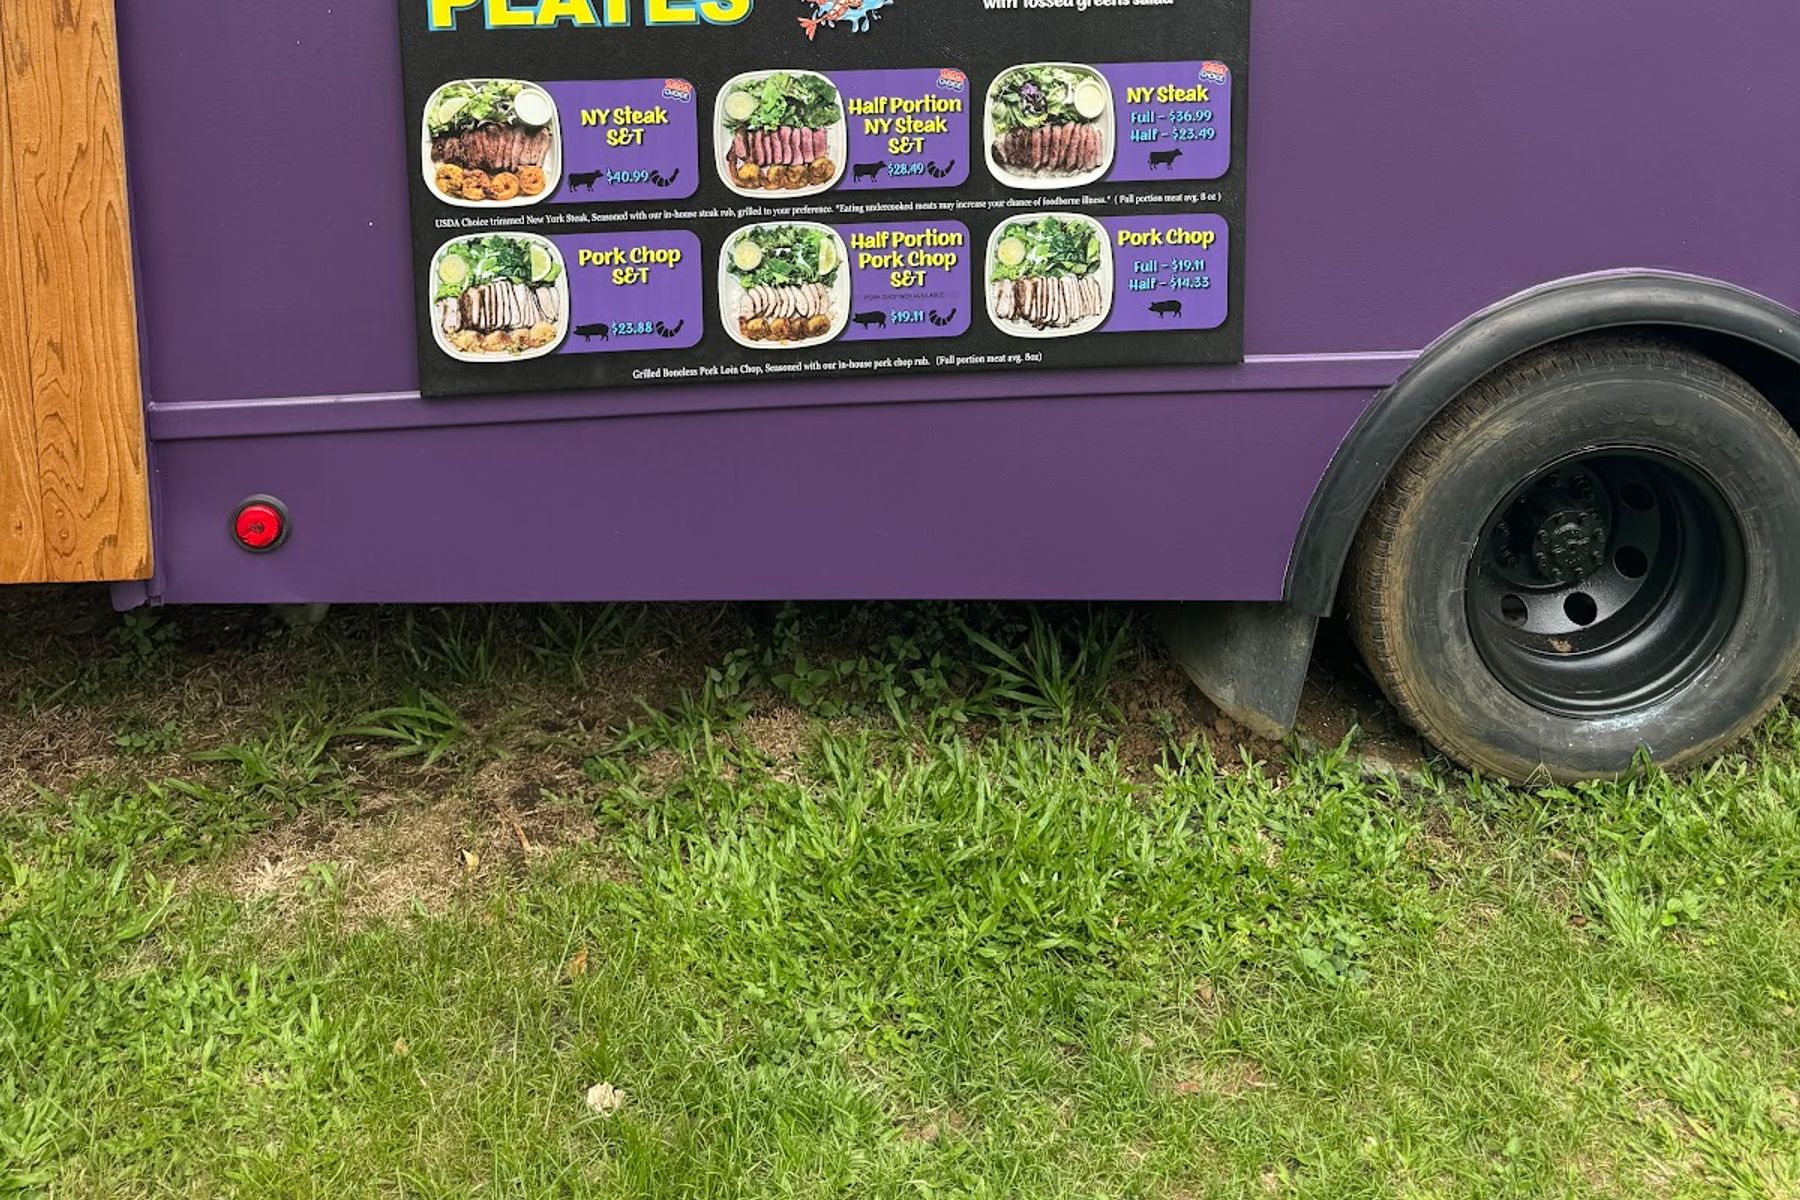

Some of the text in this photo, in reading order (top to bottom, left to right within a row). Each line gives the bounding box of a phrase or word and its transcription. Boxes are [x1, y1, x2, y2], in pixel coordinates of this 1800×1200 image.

[1126, 84, 1209, 104] NY Steak
[848, 94, 962, 115] Half Portion
[581, 105, 669, 126] NY Steak
[1130, 110, 1155, 124] Full
[1169, 109, 1212, 124] $36.99
[864, 115, 948, 135] NY Steak
[1130, 128, 1158, 141] Half
[1172, 126, 1215, 141] $23.49
[606, 128, 645, 146] S&T
[888, 136, 925, 154] S&T
[606, 168, 649, 184] $40.99
[888, 162, 924, 177] $28.49
[435, 218, 460, 228] USDA
[461, 217, 489, 227] Choice
[490, 215, 525, 226] trimmed
[526, 216, 544, 225] New
[546, 214, 565, 224] York
[566, 212, 591, 224] Steak,
[591, 211, 628, 223] Seasoned
[629, 208, 647, 220] with
[648, 211, 662, 220] our
[663, 207, 697, 219] in-house
[699, 207, 719, 218] steak
[720, 207, 736, 219] rub,
[737, 206, 762, 218] grilled
[763, 207, 772, 216] to
[772, 207, 791, 218] your
[792, 205, 834, 217] preference.
[866, 201, 914, 212] undercooked
[915, 201, 938, 211] meats
[939, 202, 955, 212] may
[956, 199, 986, 210] increase
[987, 200, 1005, 211] your
[1006, 197, 1033, 207] chance
[1033, 197, 1042, 207] of
[1042, 195, 1080, 207] foodborne
[1119, 193, 1135, 204] Full
[1135, 193, 1163, 205] portion
[1164, 193, 1183, 203] meat
[1184, 194, 1199, 204] avg.
[1200, 192, 1206, 201] 8
[851, 228, 963, 249] Half Portion
[1117, 227, 1215, 250] Pork Chop
[578, 245, 681, 268] Pork Chop
[858, 249, 957, 272] Pork Chop
[1133, 260, 1158, 273] Full
[1171, 257, 1205, 273] $19.11
[611, 267, 650, 285] S&T
[890, 270, 926, 288] S&T
[1129, 277, 1157, 290] Half
[1170, 275, 1210, 290] $14.33
[891, 308, 924, 324] $19.11
[611, 320, 653, 336] $23.88
[632, 368, 661, 379] Grilled
[663, 366, 698, 378] Boneless
[700, 365, 719, 376] Pork
[720, 364, 739, 375] Loin
[739, 363, 763, 375] Chop,
[765, 362, 802, 373] Seasoned
[803, 360, 822, 371] with
[822, 361, 837, 371] our
[838, 358, 872, 369] in-house
[874, 357, 893, 370] pork
[893, 357, 913, 368] chop
[914, 356, 931, 366] rub.
[936, 354, 955, 366] (Full
[956, 354, 985, 366] portion
[986, 353, 1006, 363] meat
[1007, 354, 1023, 364] avg.
